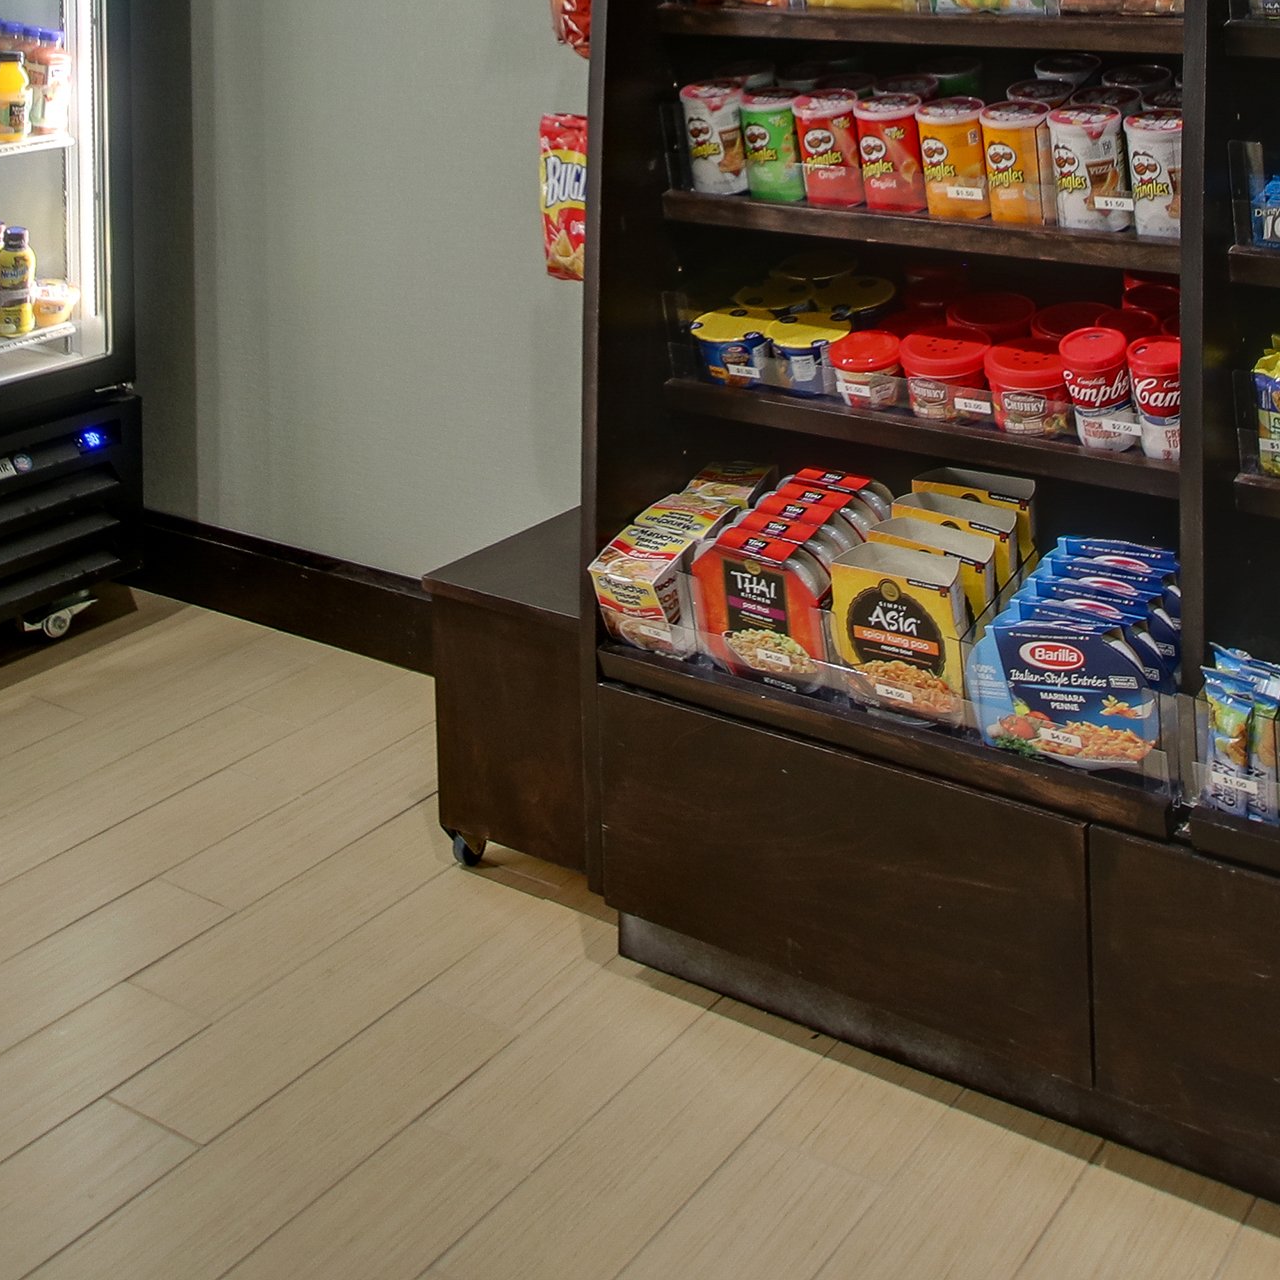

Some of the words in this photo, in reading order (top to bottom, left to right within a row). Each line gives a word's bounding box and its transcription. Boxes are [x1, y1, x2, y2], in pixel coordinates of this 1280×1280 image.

[804, 150, 843, 172] Pringles
[1131, 178, 1170, 202] Pringles
[1103, 199, 1126, 209] $1.50
[1004, 397, 1046, 412] CHUNKY
[1112, 423, 1133, 433] $2.50
[639, 528, 685, 546] Maruchan
[730, 569, 778, 600] THAI
[740, 591, 772, 604] KITCHEN
[877, 600, 908, 612] SIMPLY
[868, 605, 919, 636] Asia
[862, 629, 884, 643] spicy
[884, 633, 911, 648] kung
[911, 639, 931, 652] pao
[1033, 646, 1079, 664] Barilla
[1009, 668, 1069, 686] Italian-Style
[1070, 672, 1108, 687] Entrées
[1039, 691, 1086, 704] MARINARA
[1050, 700, 1080, 712] PENNE
[1222, 778, 1247, 789] $1.00
